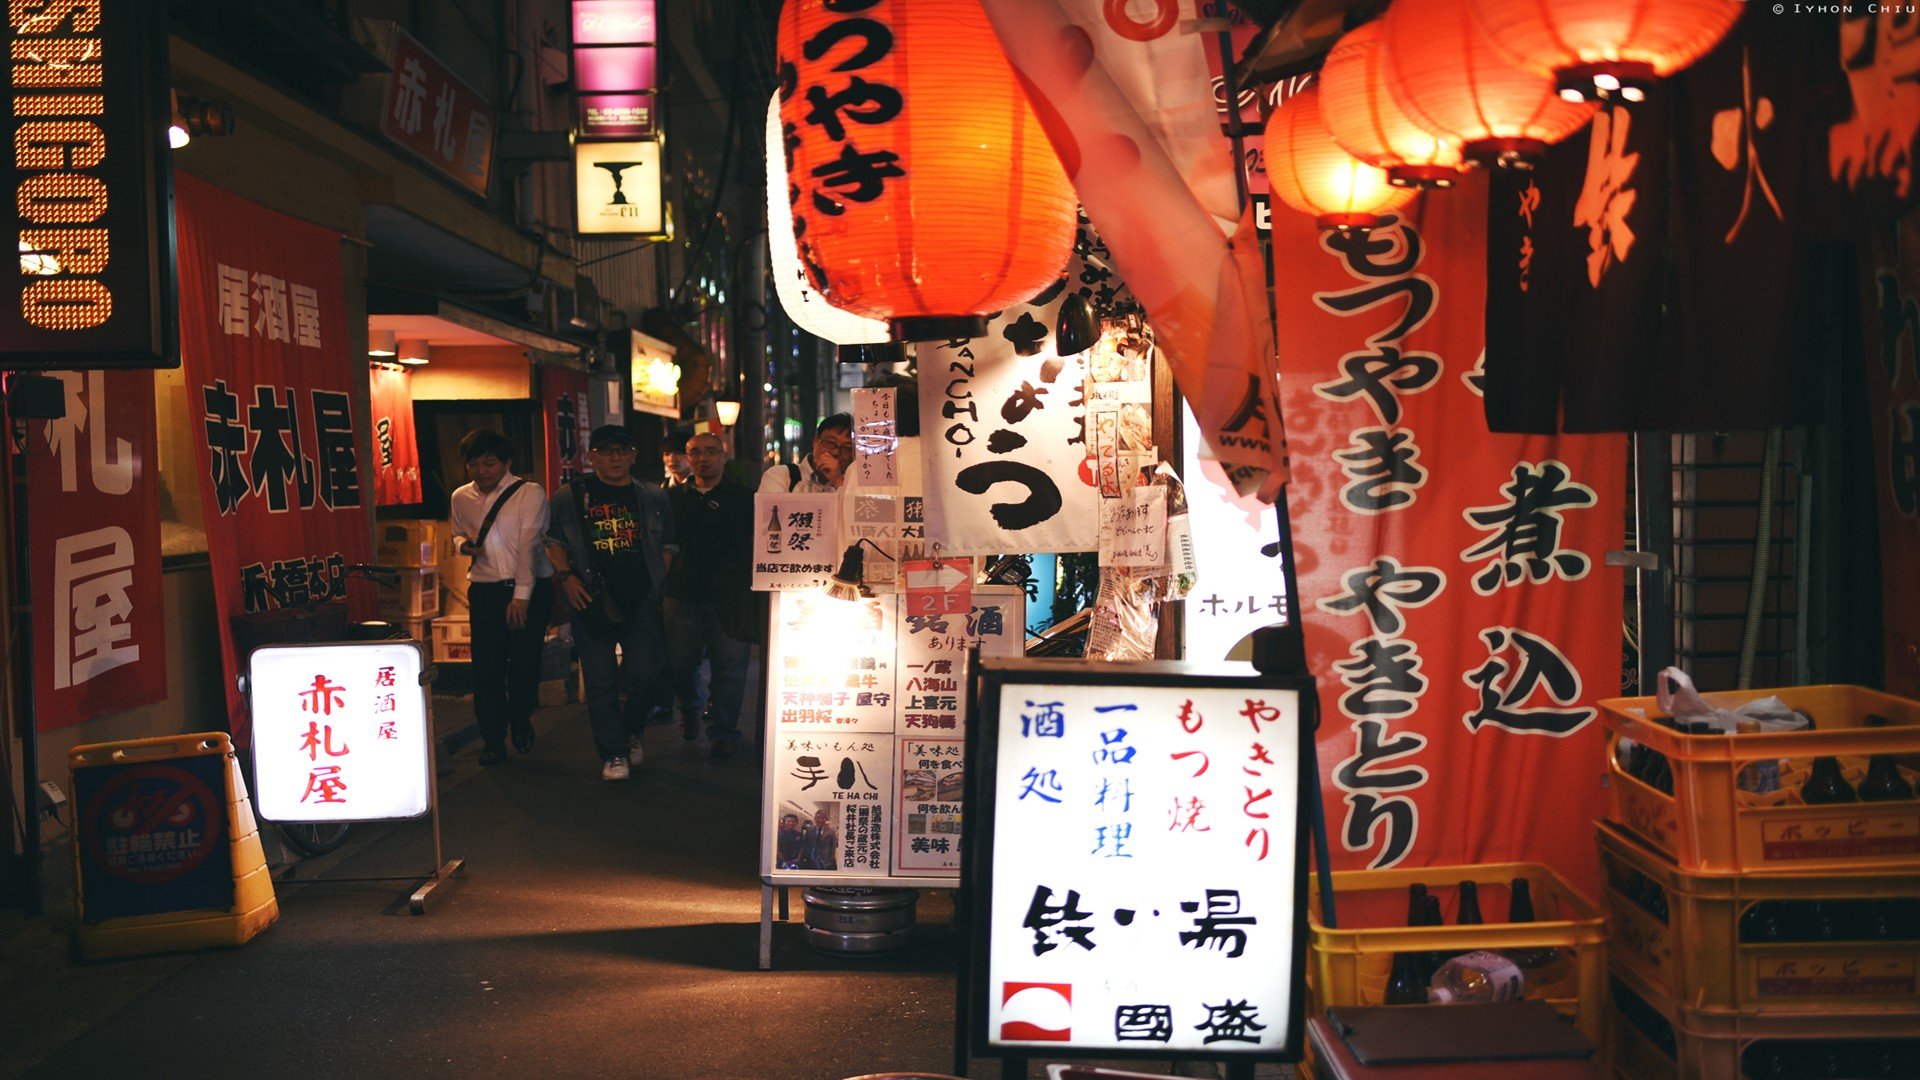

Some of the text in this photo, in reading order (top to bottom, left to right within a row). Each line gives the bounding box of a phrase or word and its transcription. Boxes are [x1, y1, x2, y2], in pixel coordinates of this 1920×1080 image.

[802, 0, 905, 216] つやき
[217, 263, 321, 349] 居酒屋
[203, 378, 361, 517] 赤札屋
[755, 563, 834, 573] 当店で飲めます
[1313, 213, 1447, 870] もつやき やきとり
[921, 594, 960, 611] 2F
[374, 666, 398, 741] 居酒屋
[905, 695, 957, 710] 上喜元
[906, 677, 957, 692] 八海山
[298, 674, 350, 805] 赤札屋
[1018, 701, 1065, 803] 酒処
[1091, 703, 1138, 858] 一品料理
[1168, 699, 1211, 833] もつ焼
[1239, 699, 1281, 861] やきとり
[832, 792, 878, 800] TE HA CHI
